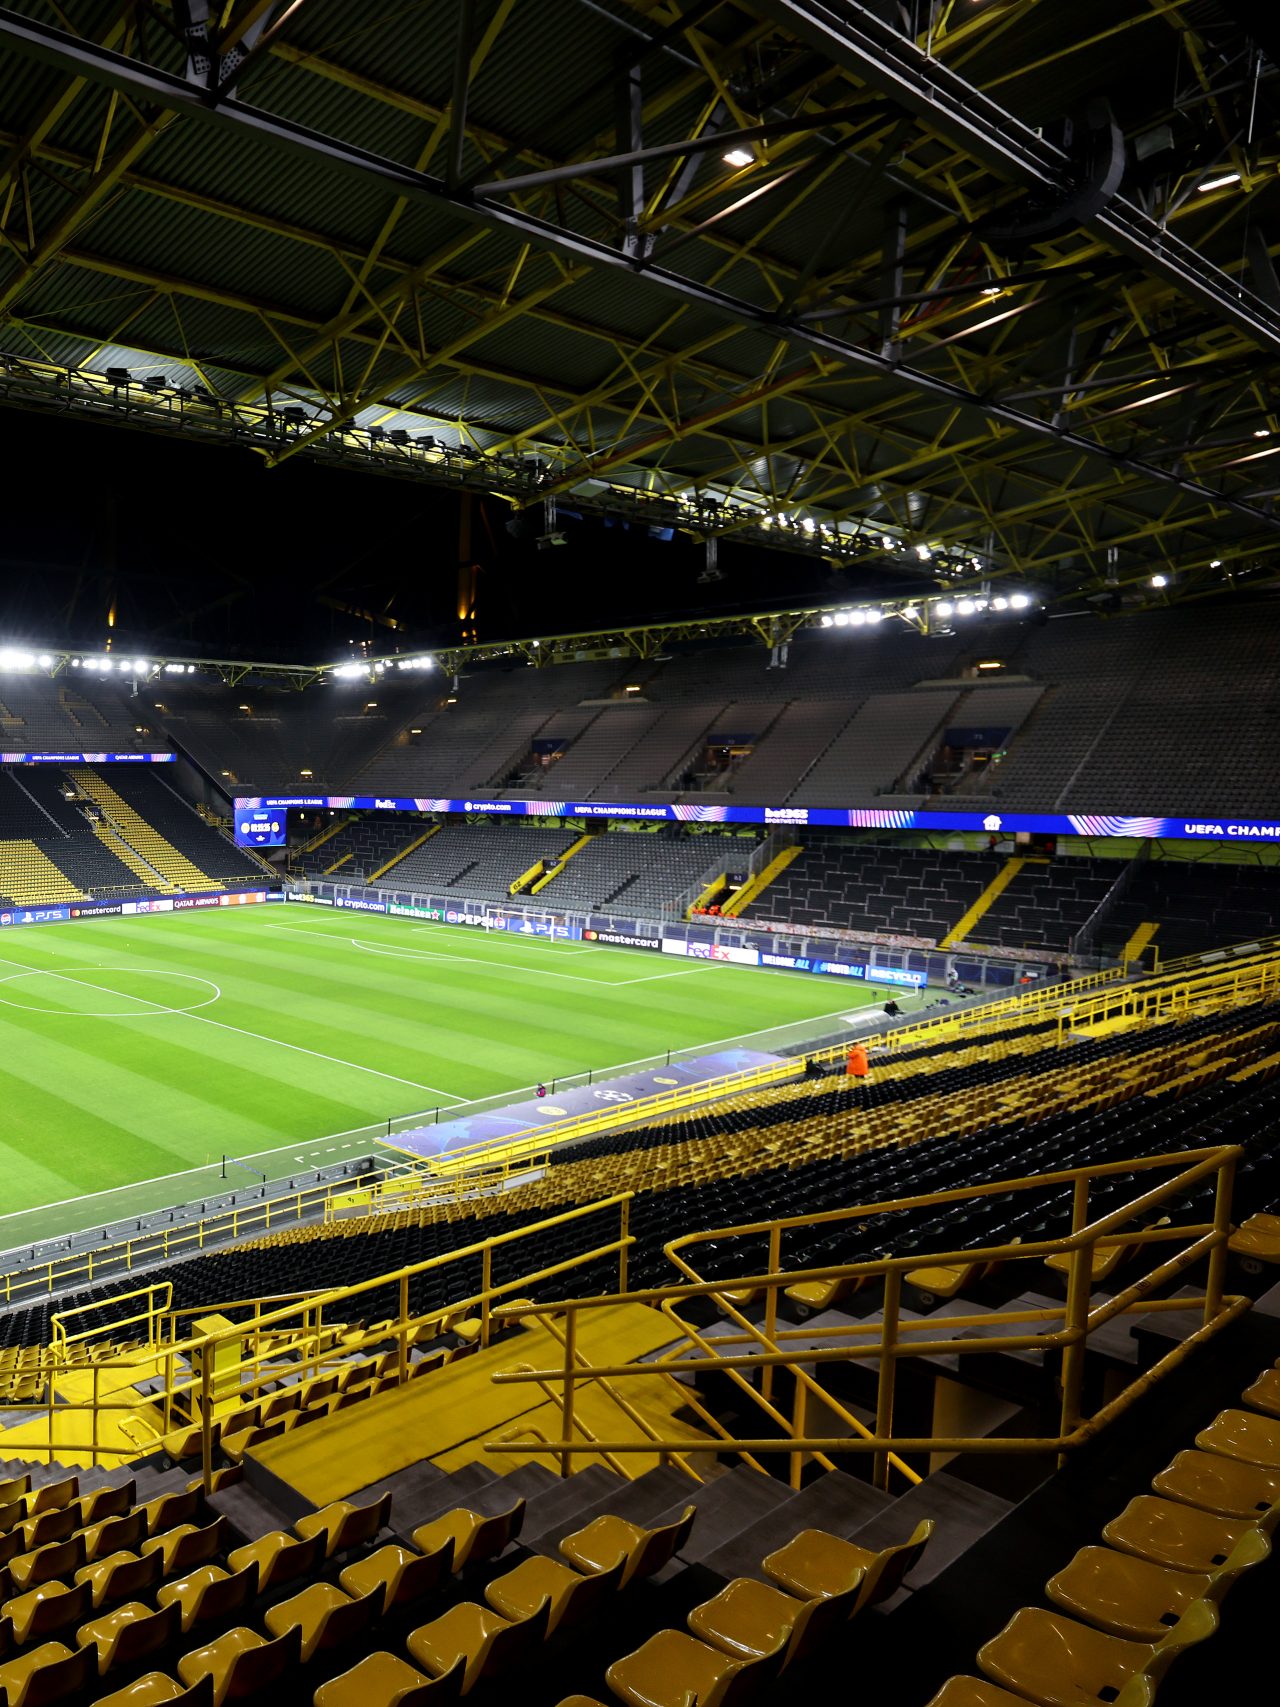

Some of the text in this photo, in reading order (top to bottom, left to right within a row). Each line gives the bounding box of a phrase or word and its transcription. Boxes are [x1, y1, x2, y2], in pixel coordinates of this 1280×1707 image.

[473, 803, 511, 811] crypto.com
[593, 807, 636, 815] CHAMPIONS
[637, 808, 667, 816] LEAGUE
[1184, 824, 1224, 834] UEFA
[174, 899, 194, 908] QATAR
[344, 900, 385, 911] crypto.com
[35, 911, 62, 920] PS5
[81, 906, 121, 915] mastercard
[390, 904, 431, 918] Heineken
[457, 913, 493, 927] PEPSI
[535, 924, 569, 936] PS5
[598, 932, 658, 948] mastercard
